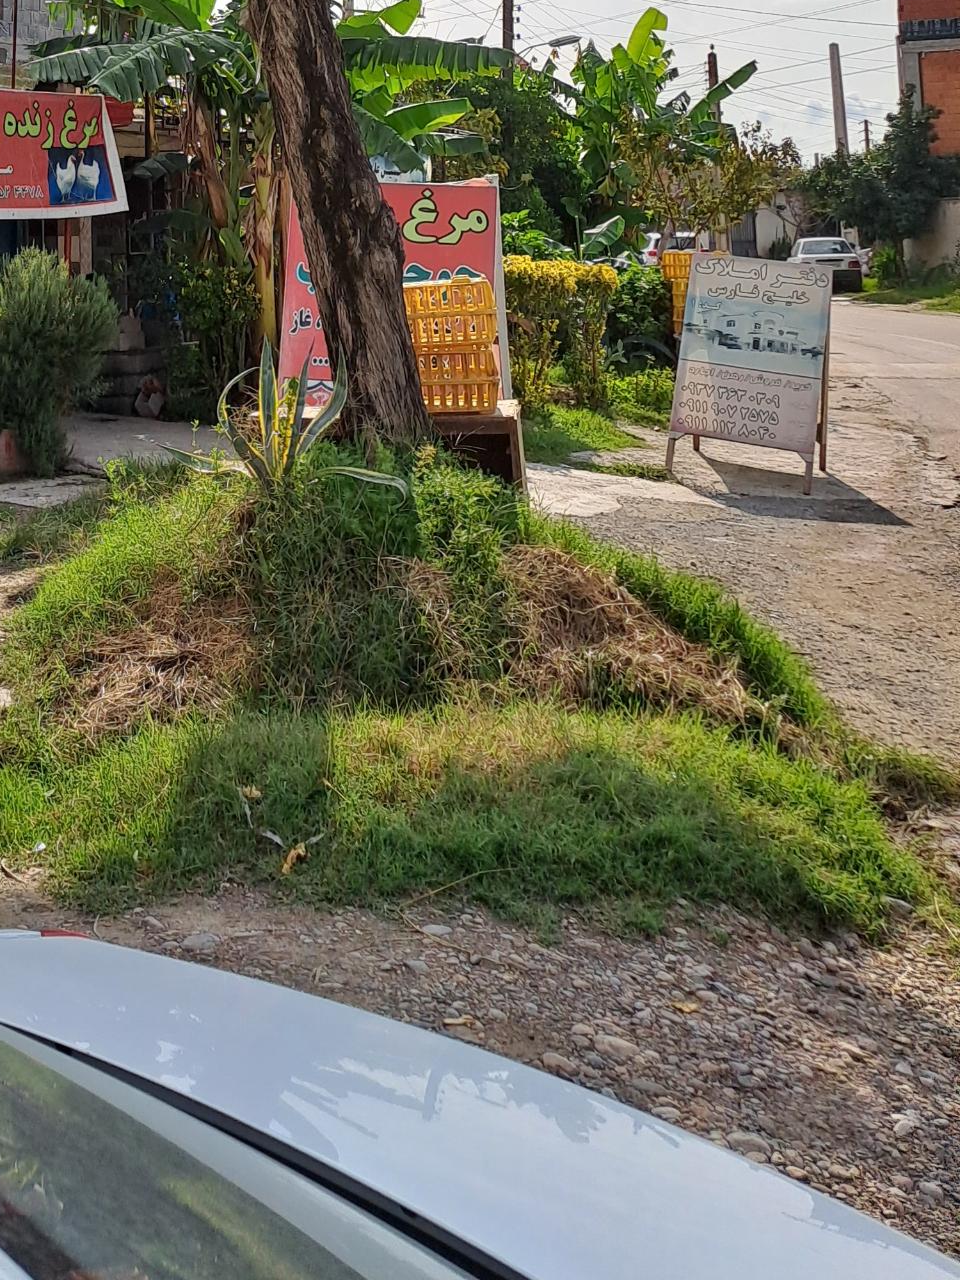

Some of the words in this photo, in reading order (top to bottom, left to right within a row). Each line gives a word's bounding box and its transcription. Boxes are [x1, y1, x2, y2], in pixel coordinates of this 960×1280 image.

[3, 100, 55, 150] زنده
[60, 99, 99, 150] مرغ
[401, 188, 489, 245] مرغ
[695, 258, 768, 281] املاک
[769, 267, 829, 289] دفتر
[707, 282, 761, 300] فارس
[762, 290, 810, 306] خلیج
[289, 306, 313, 335] غاز
[679, 398, 708, 414] ۰۹۱۱
[711, 401, 738, 418] ۹۰۷
[678, 414, 707, 431] ۰۹۱۱
